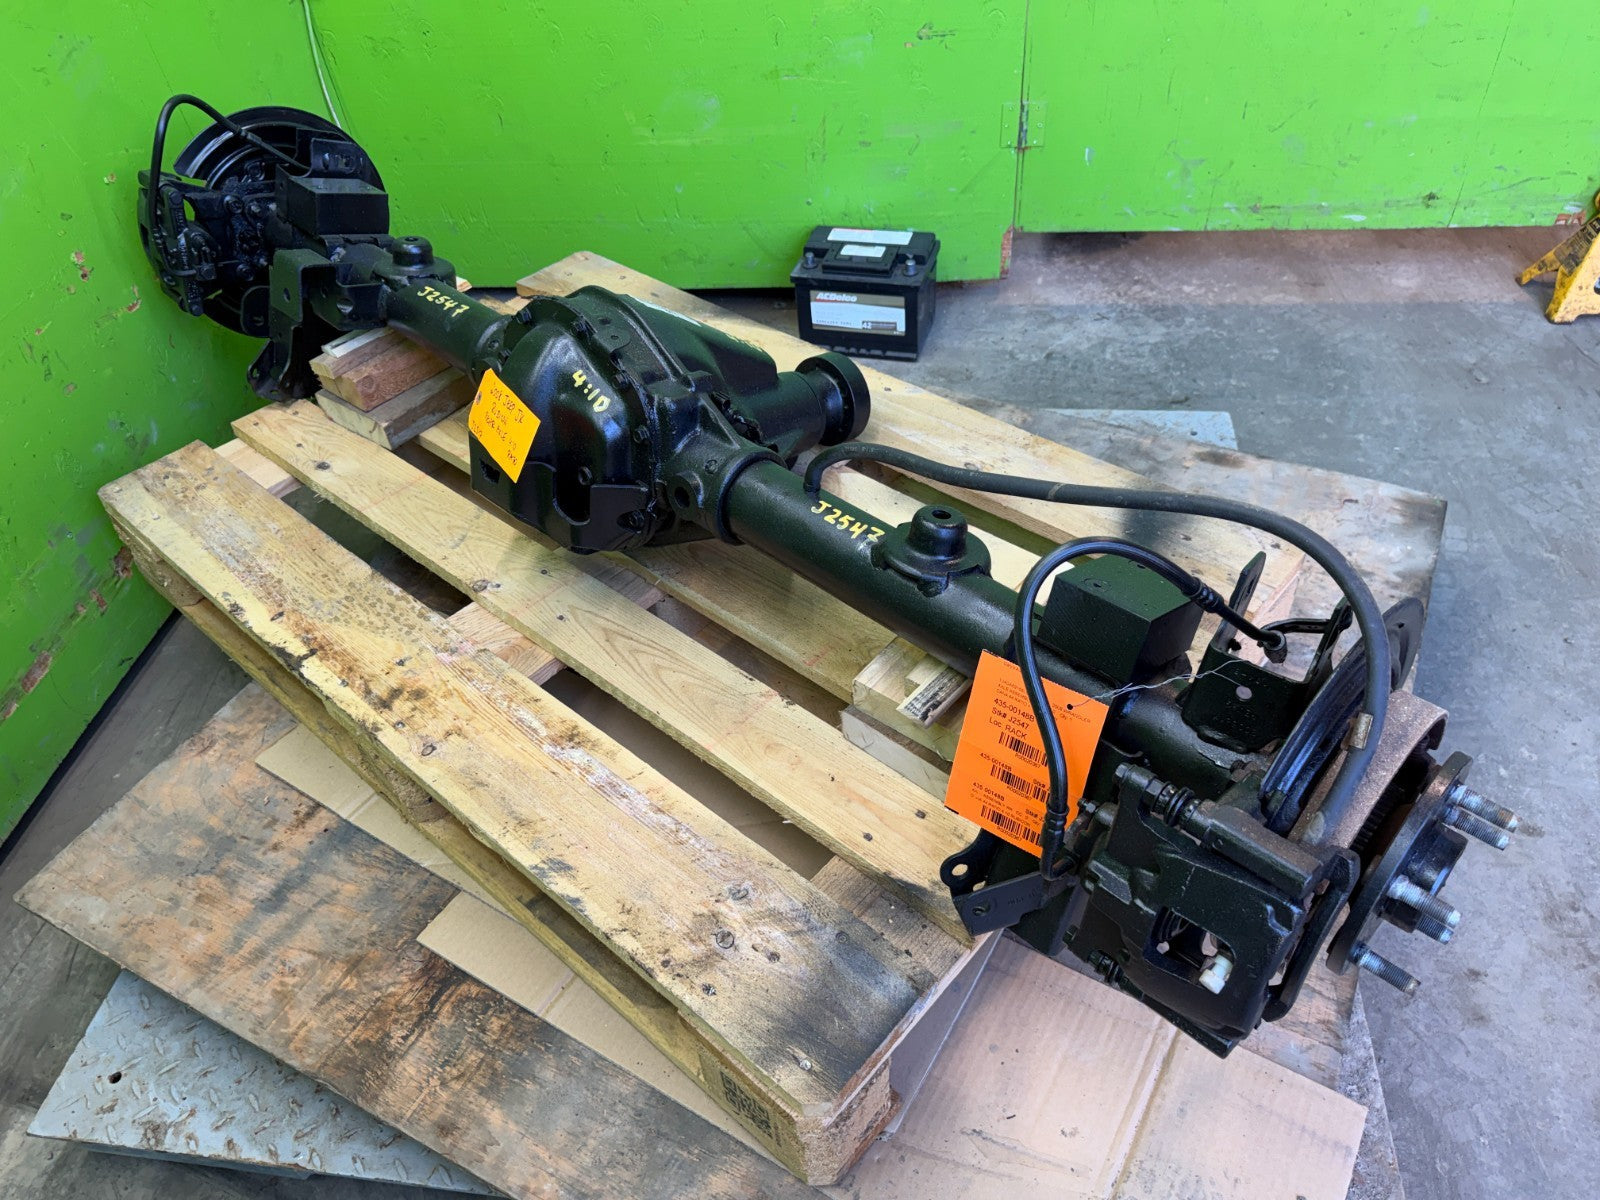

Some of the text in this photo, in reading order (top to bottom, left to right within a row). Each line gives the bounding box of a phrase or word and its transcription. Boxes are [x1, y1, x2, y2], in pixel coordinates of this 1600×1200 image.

[417, 286, 470, 318] J2547
[816, 292, 857, 302] ACDelco
[572, 369, 611, 413] 4:10
[811, 500, 886, 543] J2547
[994, 698, 1035, 723] 435-00148B
[1008, 716, 1030, 730] J2547
[989, 716, 1028, 740] Loc RACK
